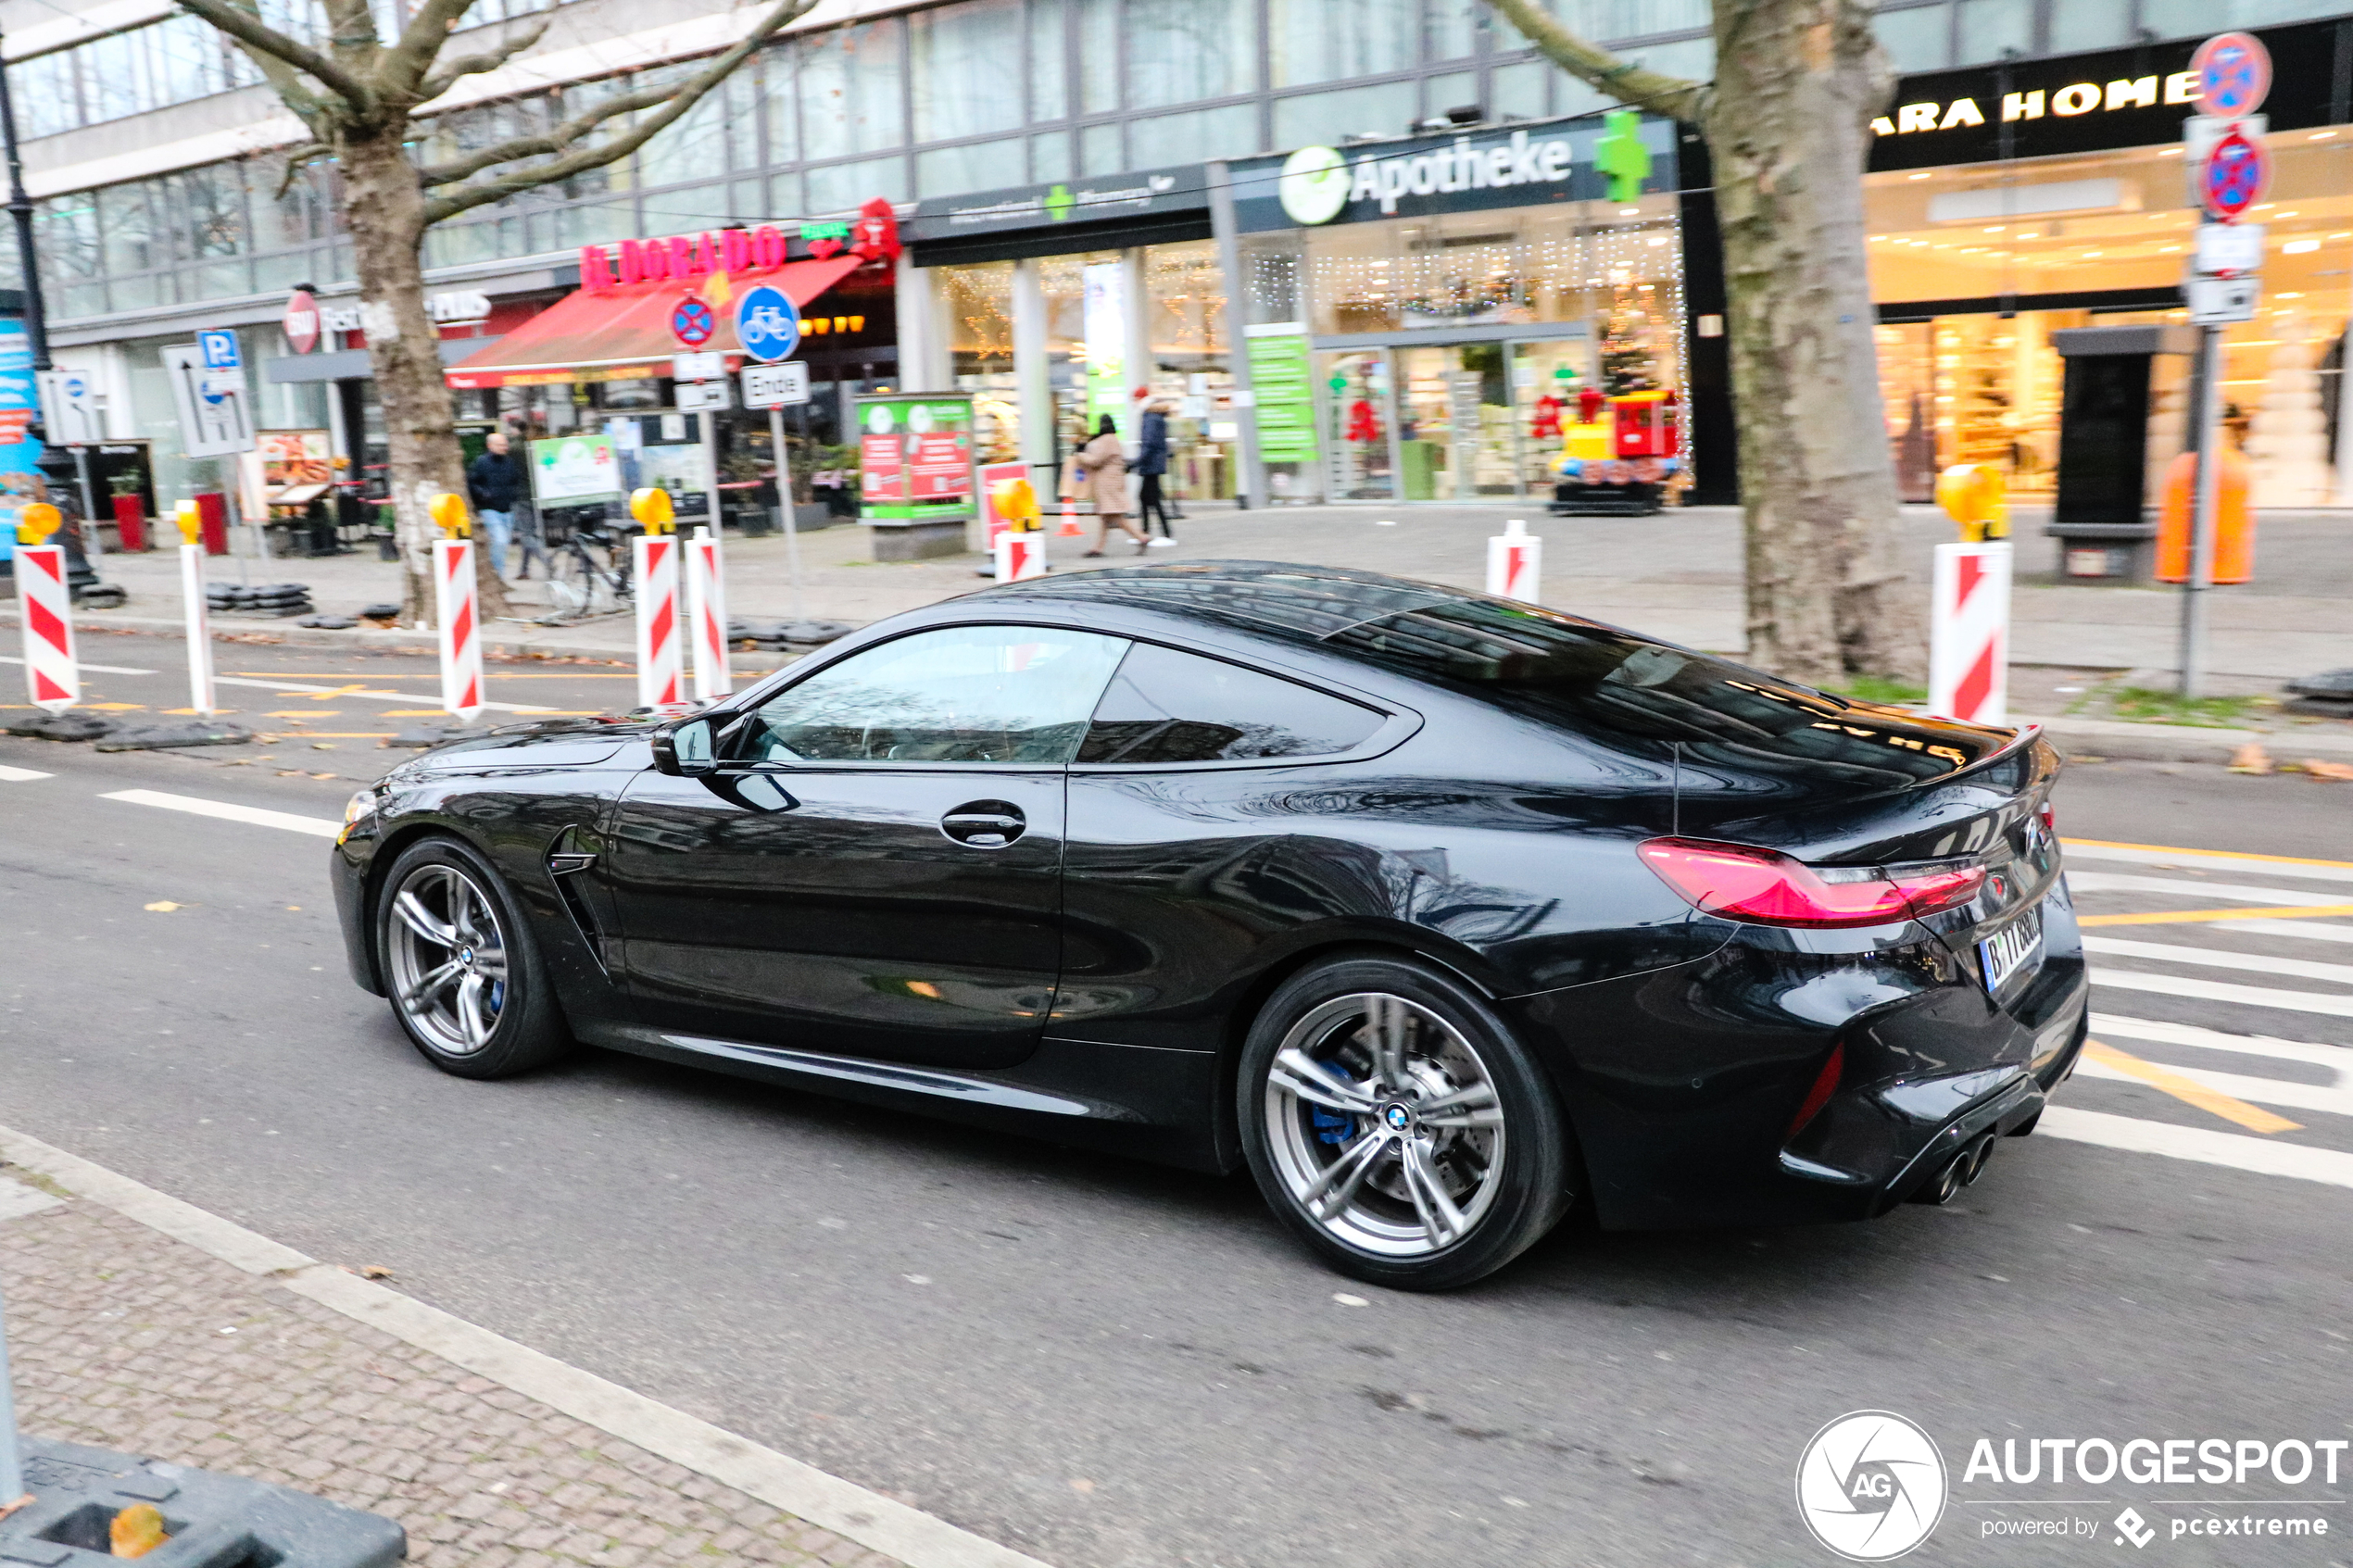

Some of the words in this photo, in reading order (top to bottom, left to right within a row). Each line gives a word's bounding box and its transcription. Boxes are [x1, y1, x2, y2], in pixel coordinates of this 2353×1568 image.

[1869, 97, 1985, 136] ARA
[2002, 70, 2205, 122] HOME
[1349, 130, 1573, 214] Apotheke
[618, 225, 786, 283] DORADO
[205, 335, 231, 365] P
[750, 372, 797, 396] Ende
[1988, 940, 2002, 980] B
